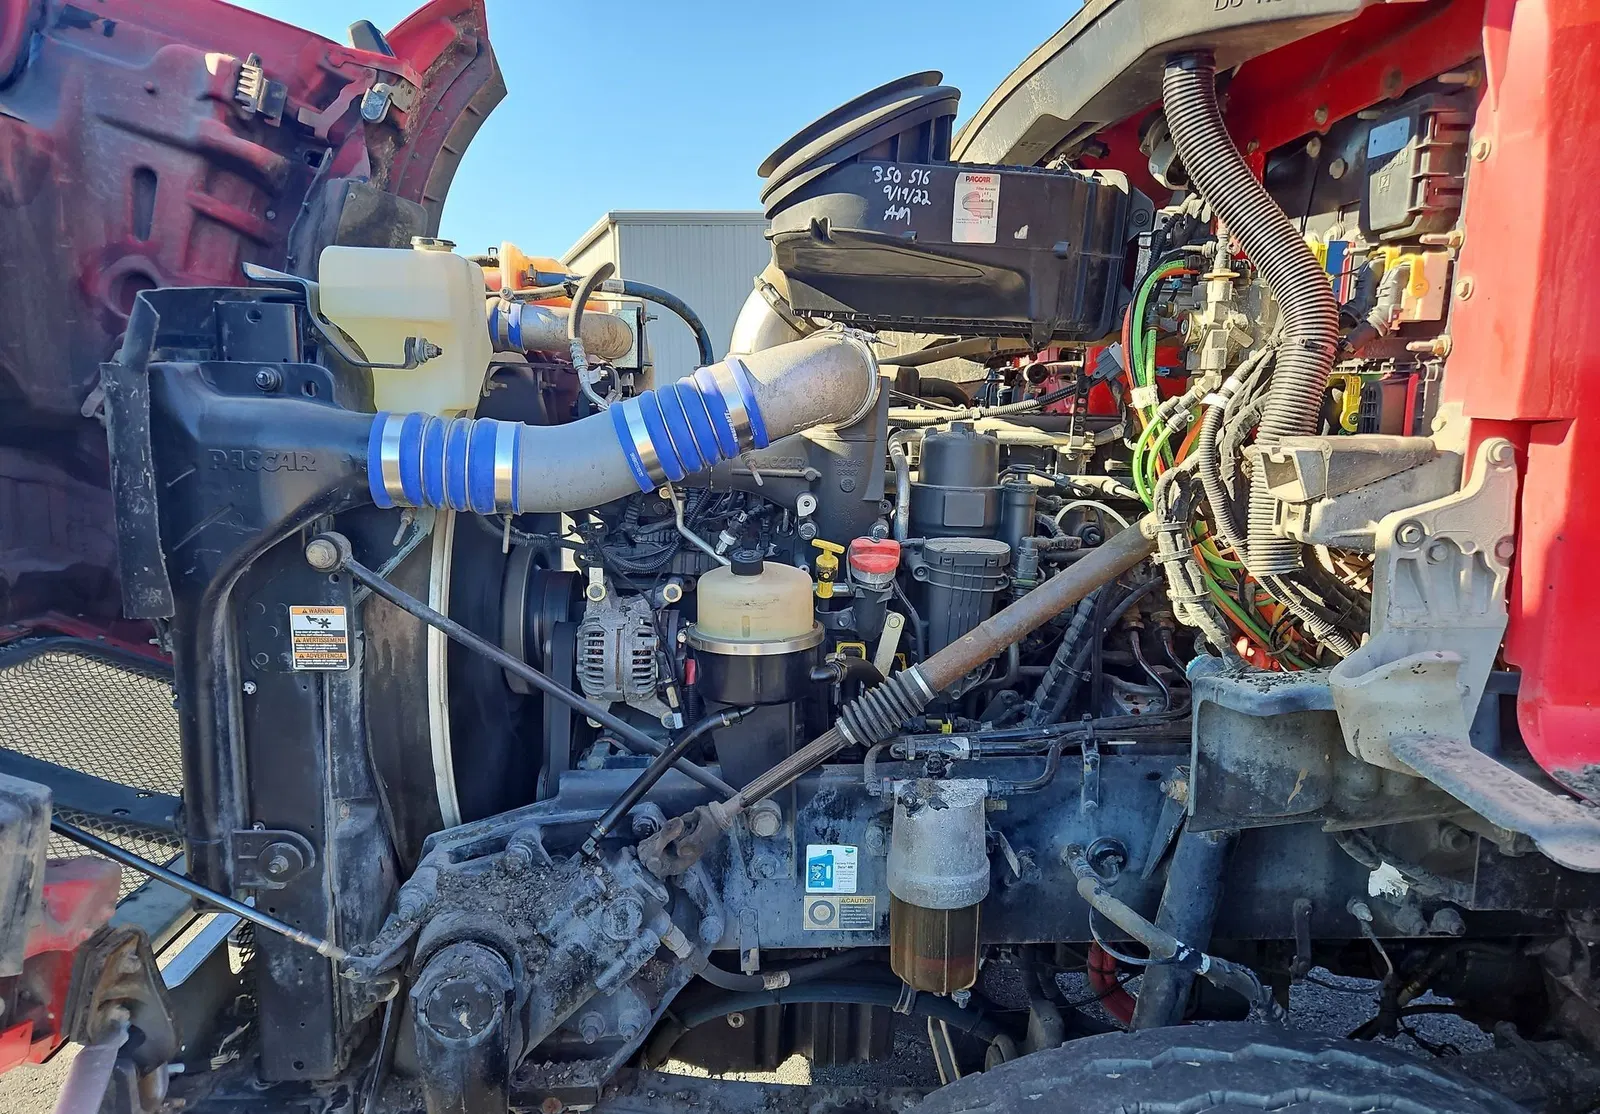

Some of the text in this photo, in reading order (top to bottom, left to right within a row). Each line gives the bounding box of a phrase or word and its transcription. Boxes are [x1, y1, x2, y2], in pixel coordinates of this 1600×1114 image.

[872, 166, 931, 185] 350 516
[207, 448, 317, 472] PACCAR
[753, 456, 806, 470] ACCAR
